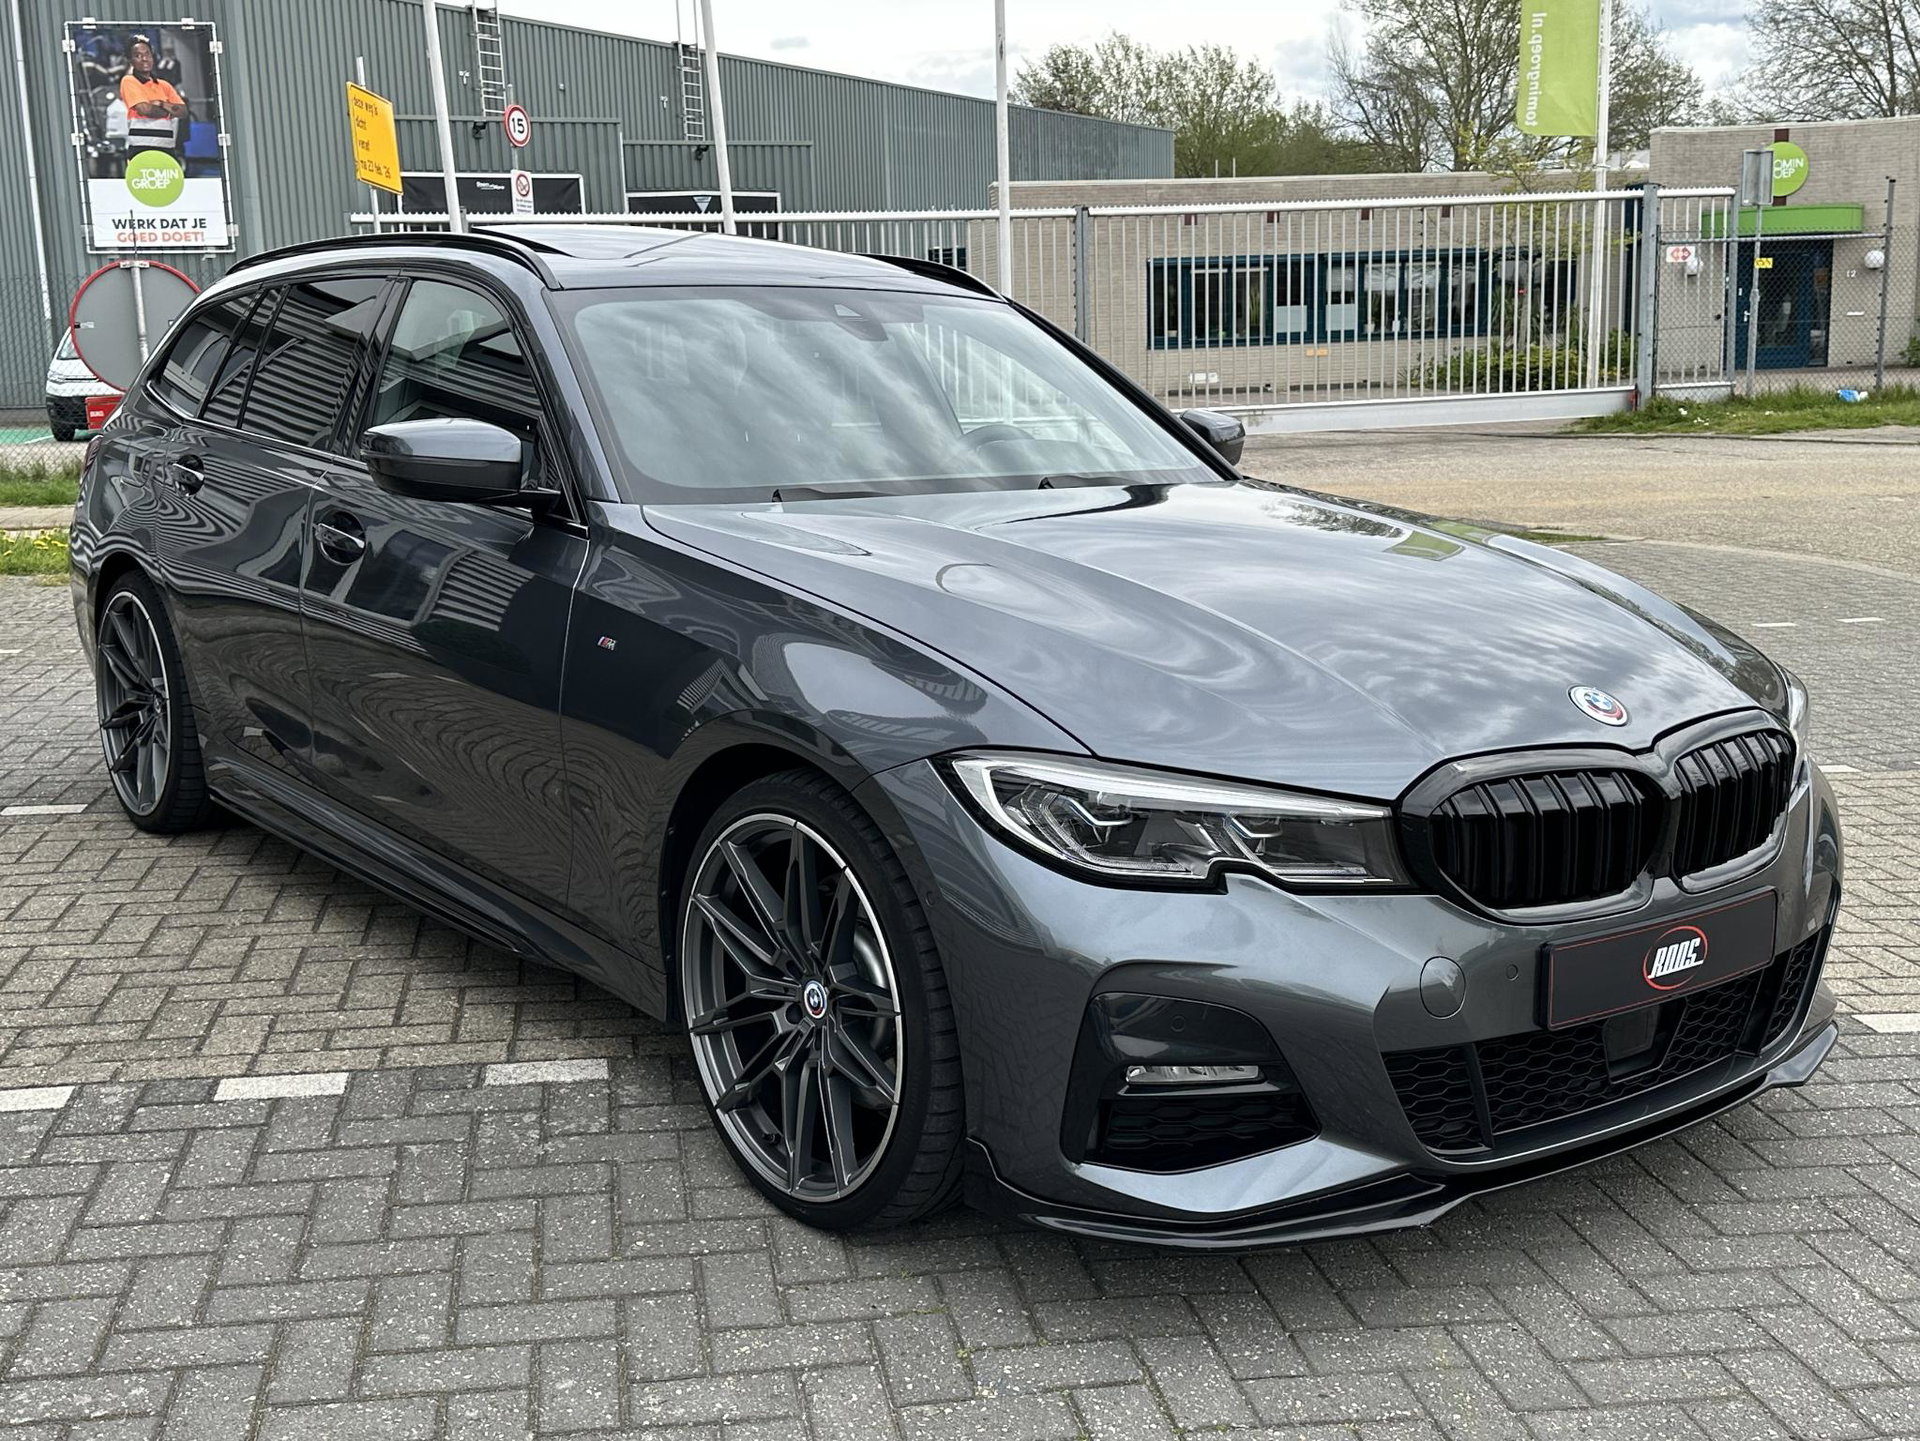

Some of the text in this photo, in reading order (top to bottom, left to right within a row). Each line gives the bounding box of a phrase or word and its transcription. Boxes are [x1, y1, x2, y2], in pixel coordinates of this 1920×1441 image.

[511, 117, 525, 134] 15
[1774, 158, 1804, 168] OMIN
[140, 168, 179, 180] TOMIN
[1774, 168, 1795, 179] OEP
[131, 178, 170, 189] GROEP
[112, 218, 207, 229] WERK DAT JE
[117, 231, 205, 242] GOED DOET!
[1648, 937, 1704, 979] ROOS
